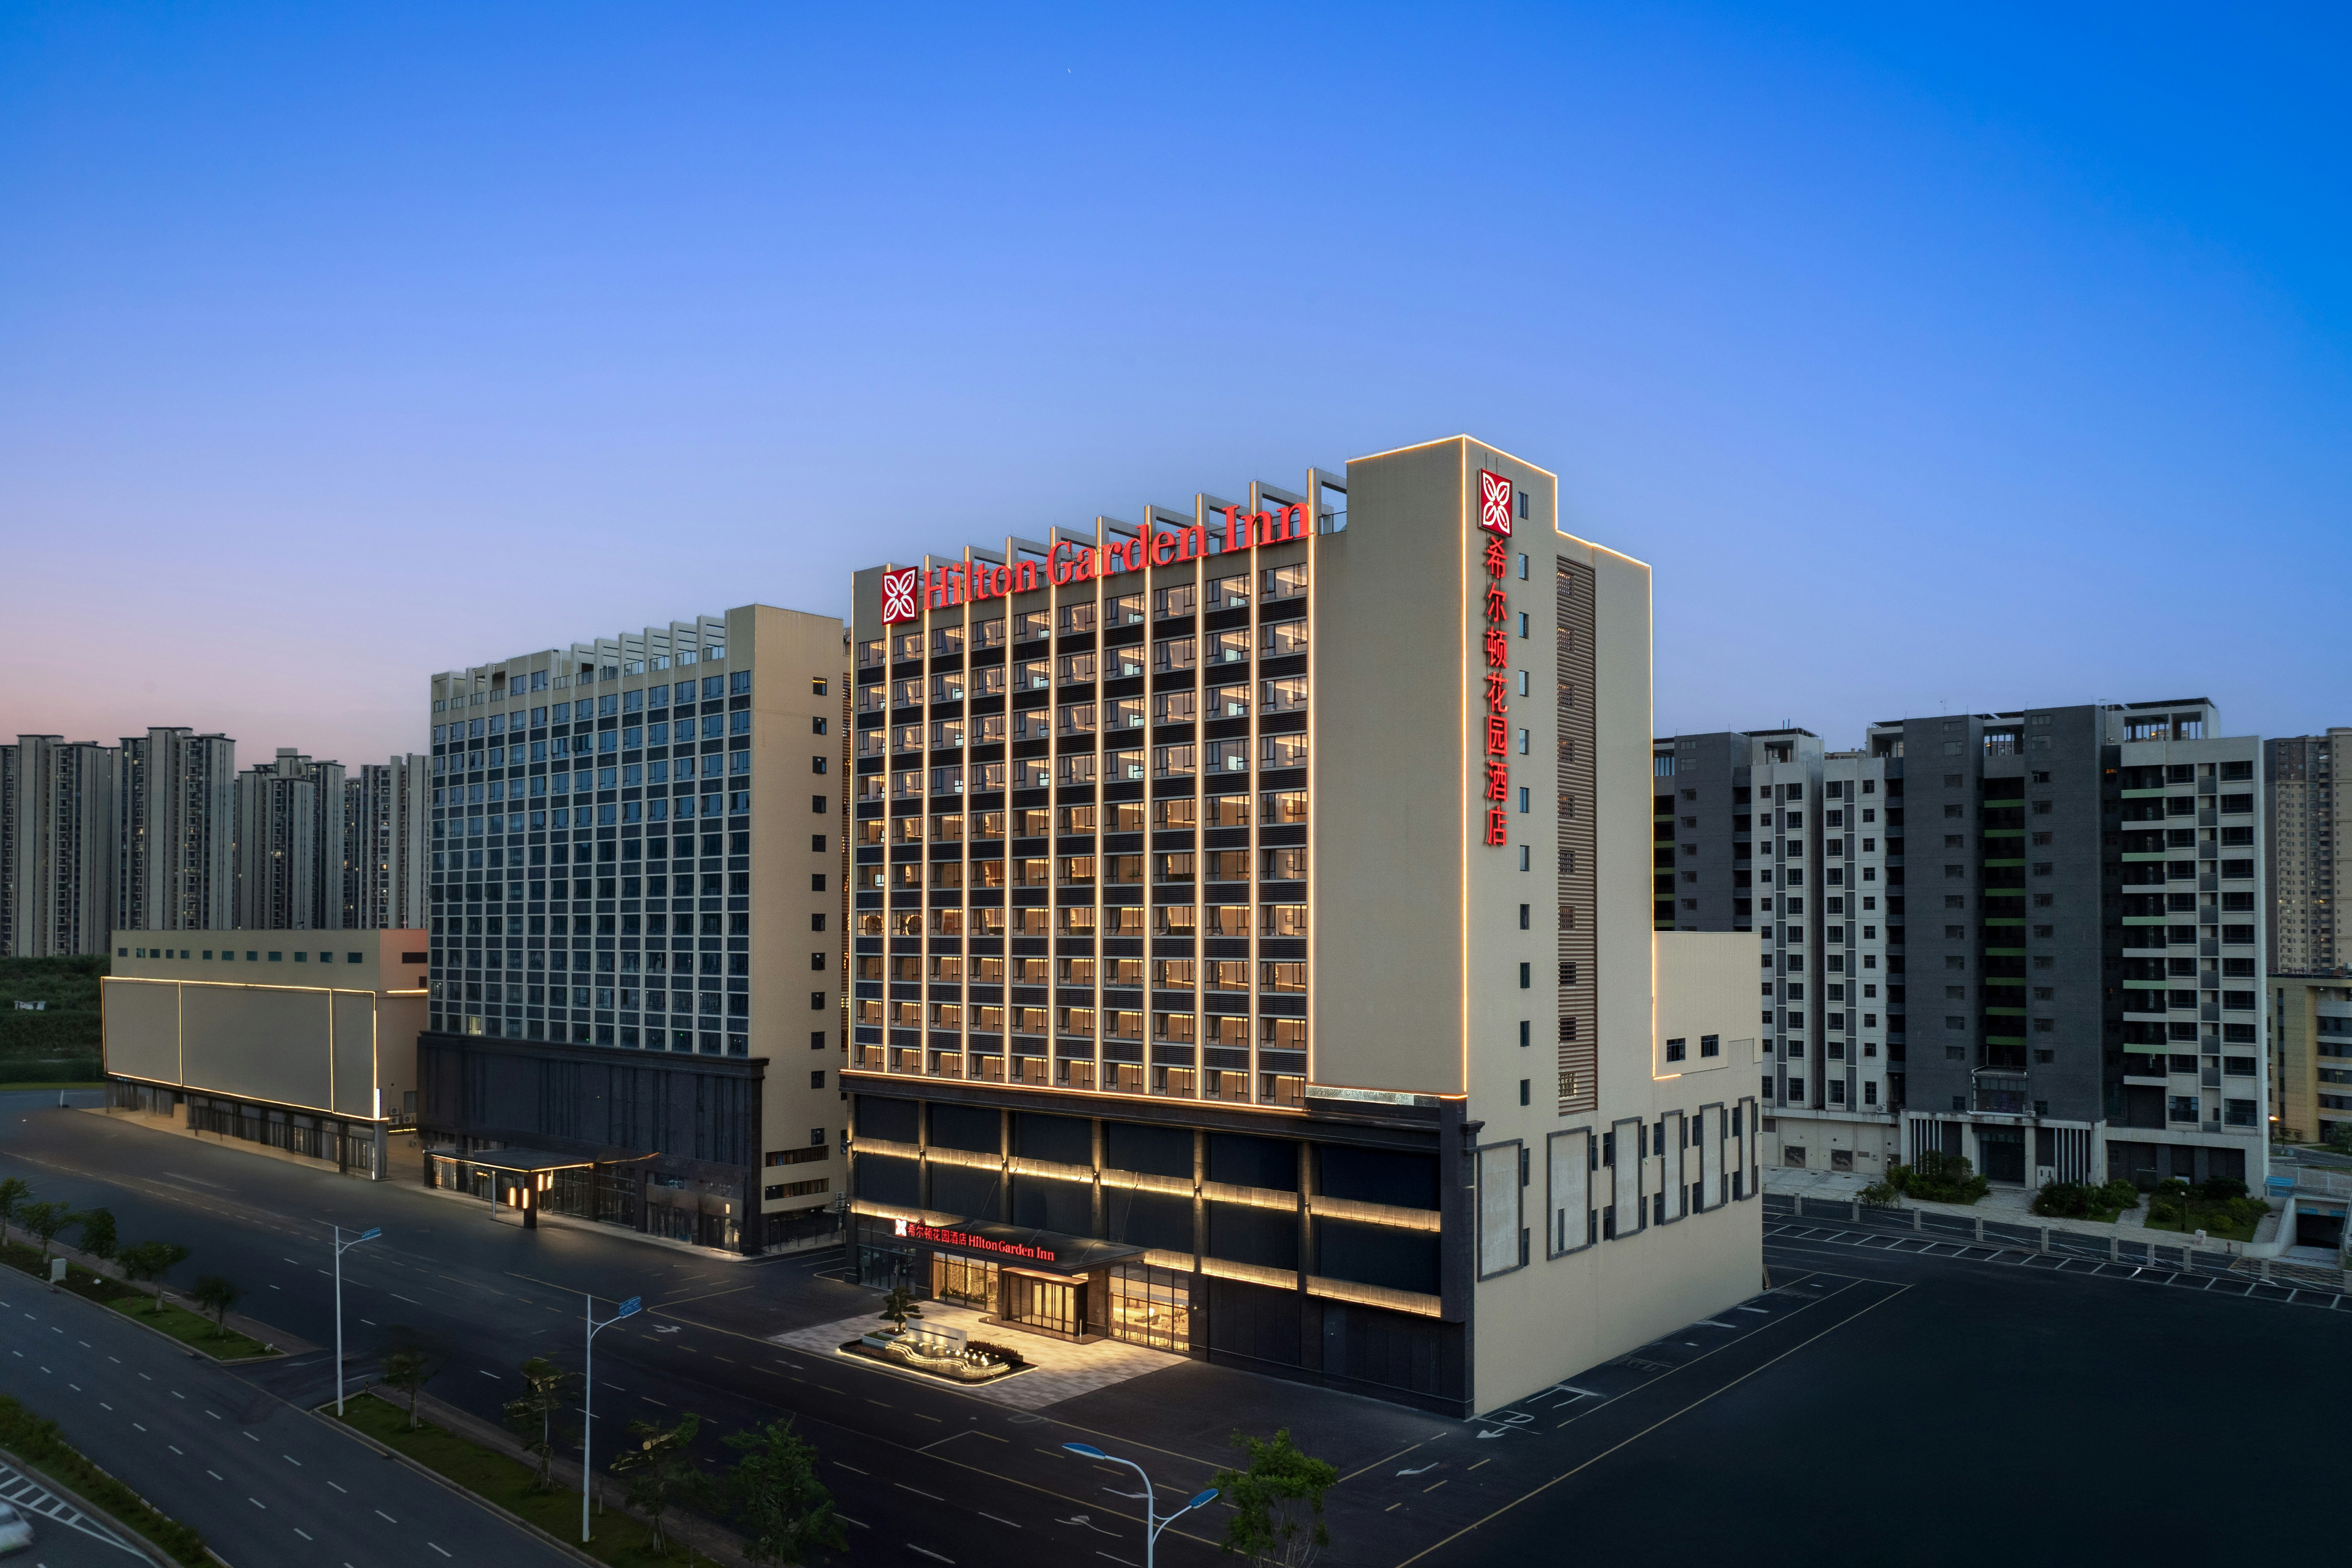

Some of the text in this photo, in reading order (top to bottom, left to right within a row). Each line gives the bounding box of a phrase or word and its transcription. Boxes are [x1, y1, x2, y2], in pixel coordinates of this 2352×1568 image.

[922, 503, 1313, 610] Hilton Garden Inn
[1486, 535, 1508, 846] 希尔顿花园酒店
[907, 1222, 1055, 1261] 希尔顿花园酒店 Hilton Garden Inn
